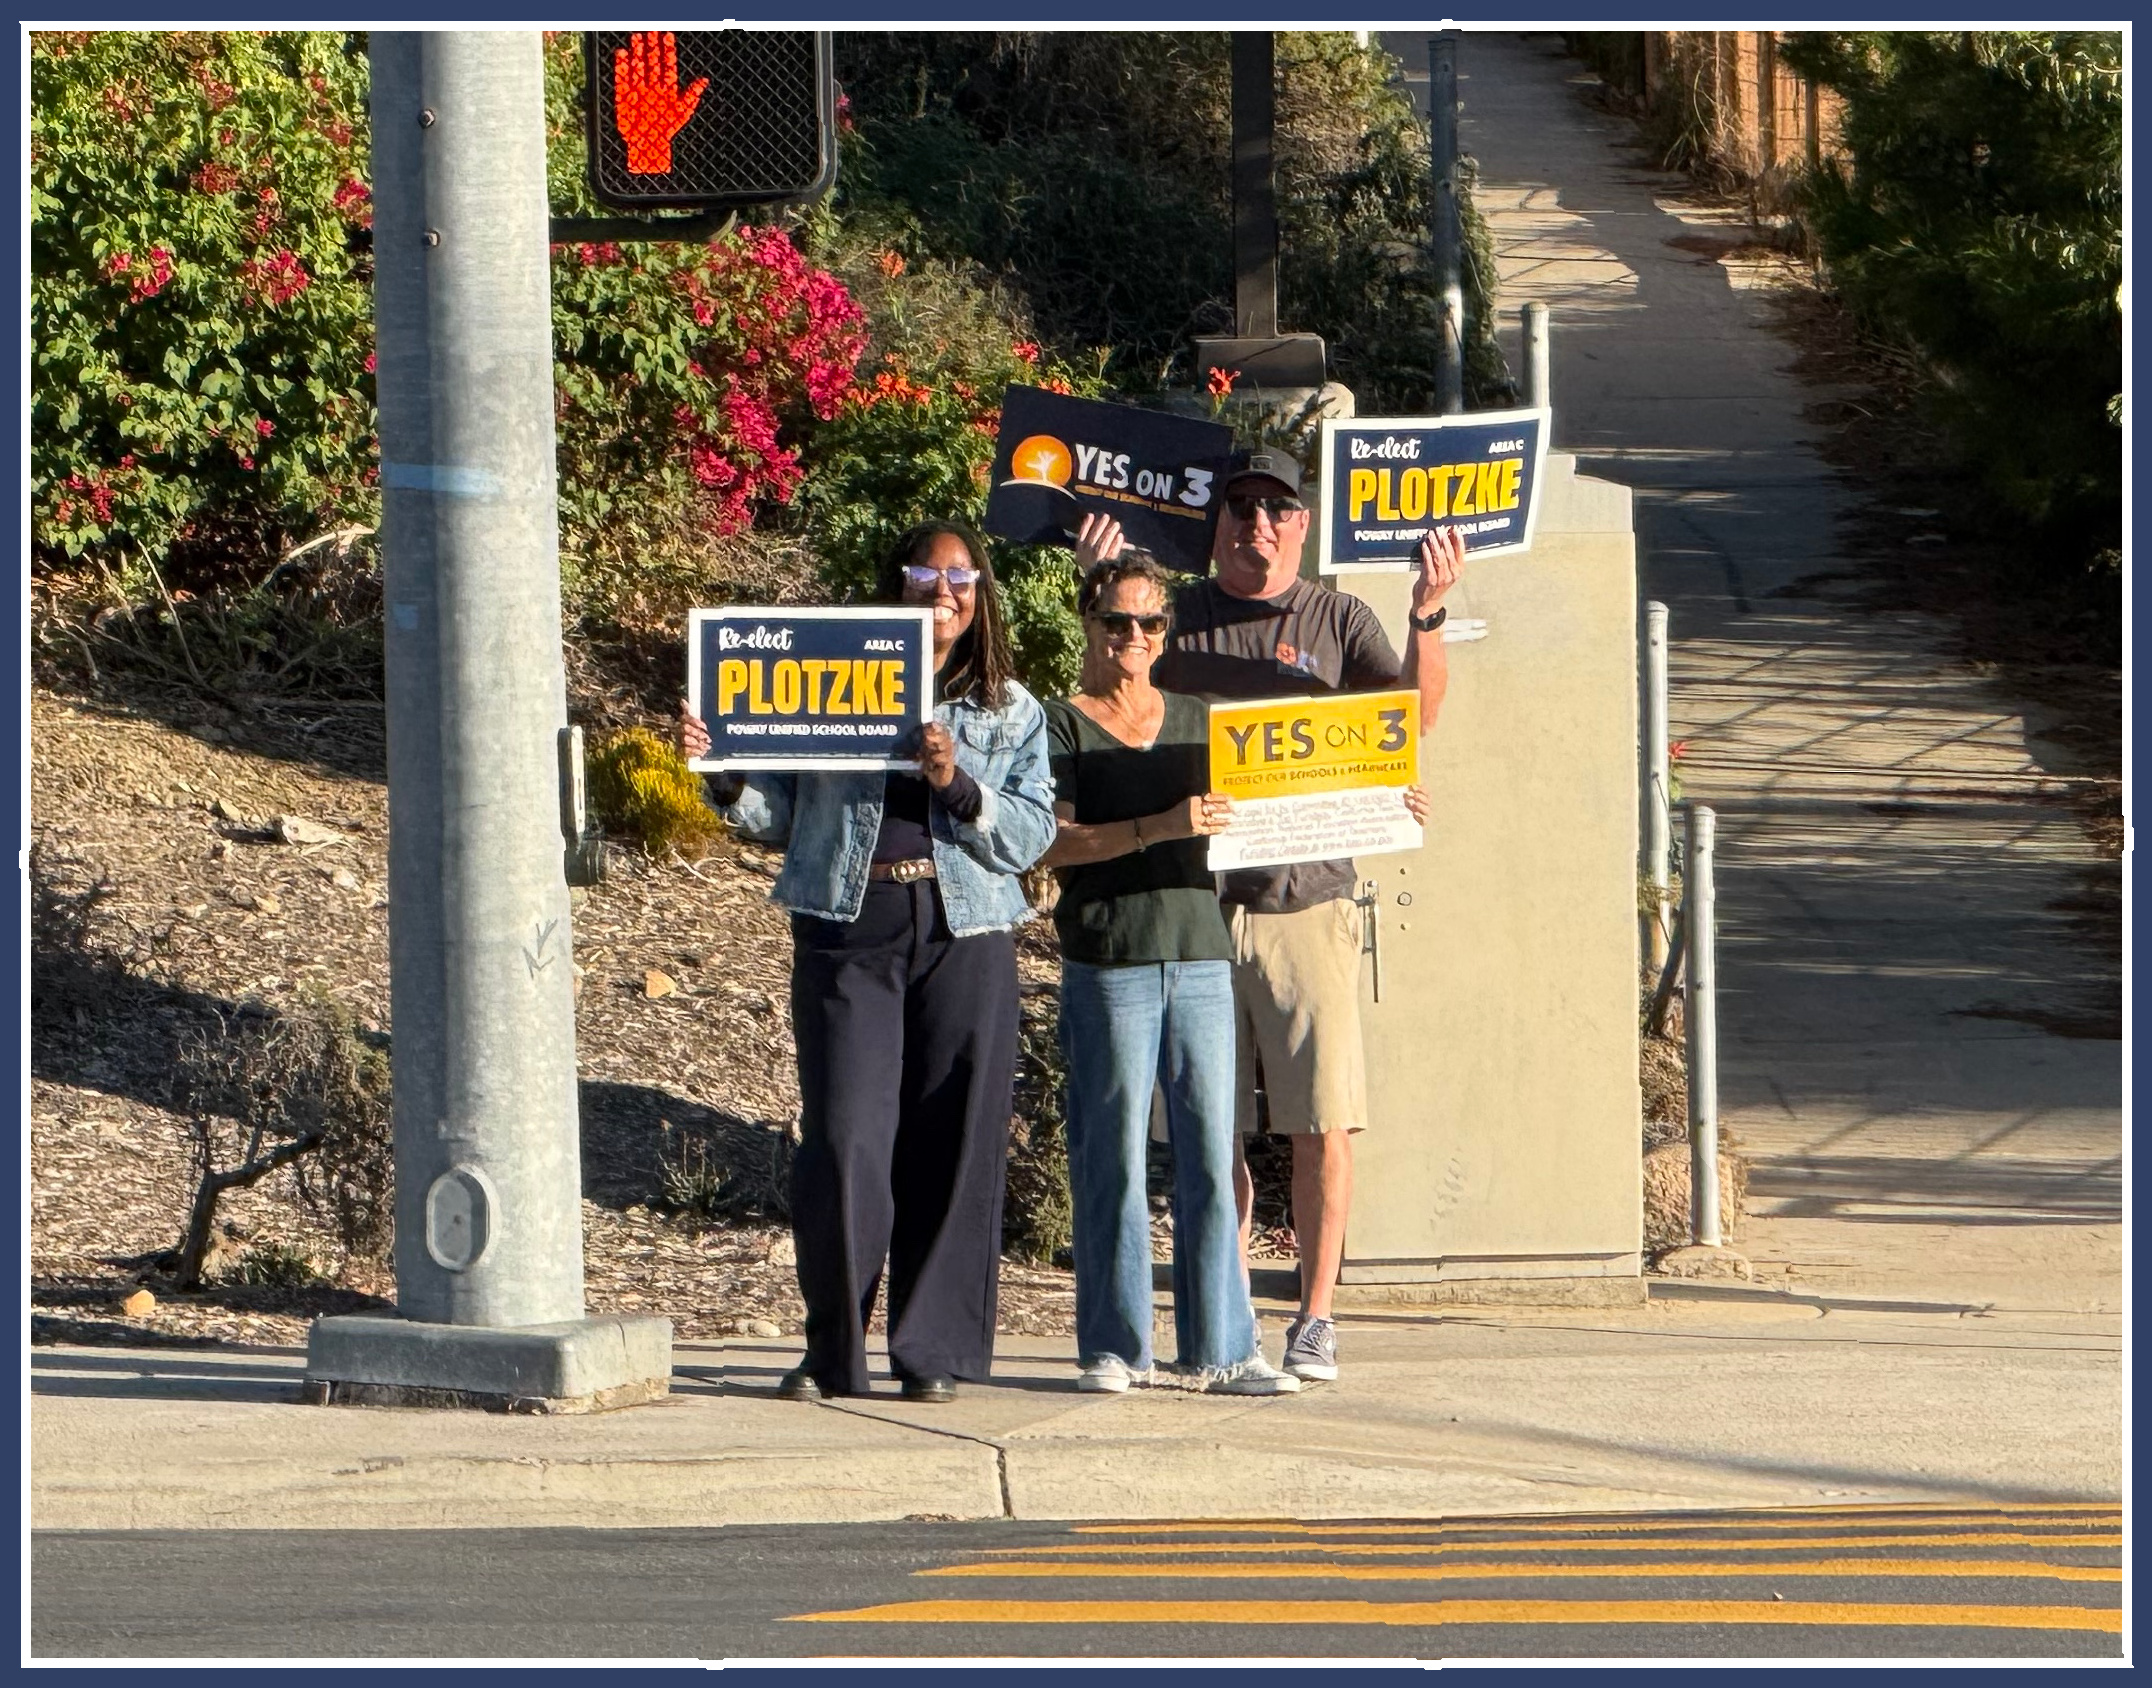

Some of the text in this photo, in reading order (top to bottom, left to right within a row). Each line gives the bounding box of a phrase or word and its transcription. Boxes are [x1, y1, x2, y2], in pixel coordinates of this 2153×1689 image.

[1351, 436, 1421, 459] Re-elect
[1075, 443, 1131, 489] YES
[1136, 469, 1173, 500] ON
[1178, 466, 1213, 507] 3
[1349, 458, 1524, 522] PLOTZKE
[719, 625, 793, 651] Re-elect
[864, 640, 905, 651] AREA C
[718, 659, 906, 716] PLOTZKE
[812, 724, 857, 736] SCHOOL
[858, 724, 898, 736] BOARD
[1224, 708, 1407, 766] YES ON 3
